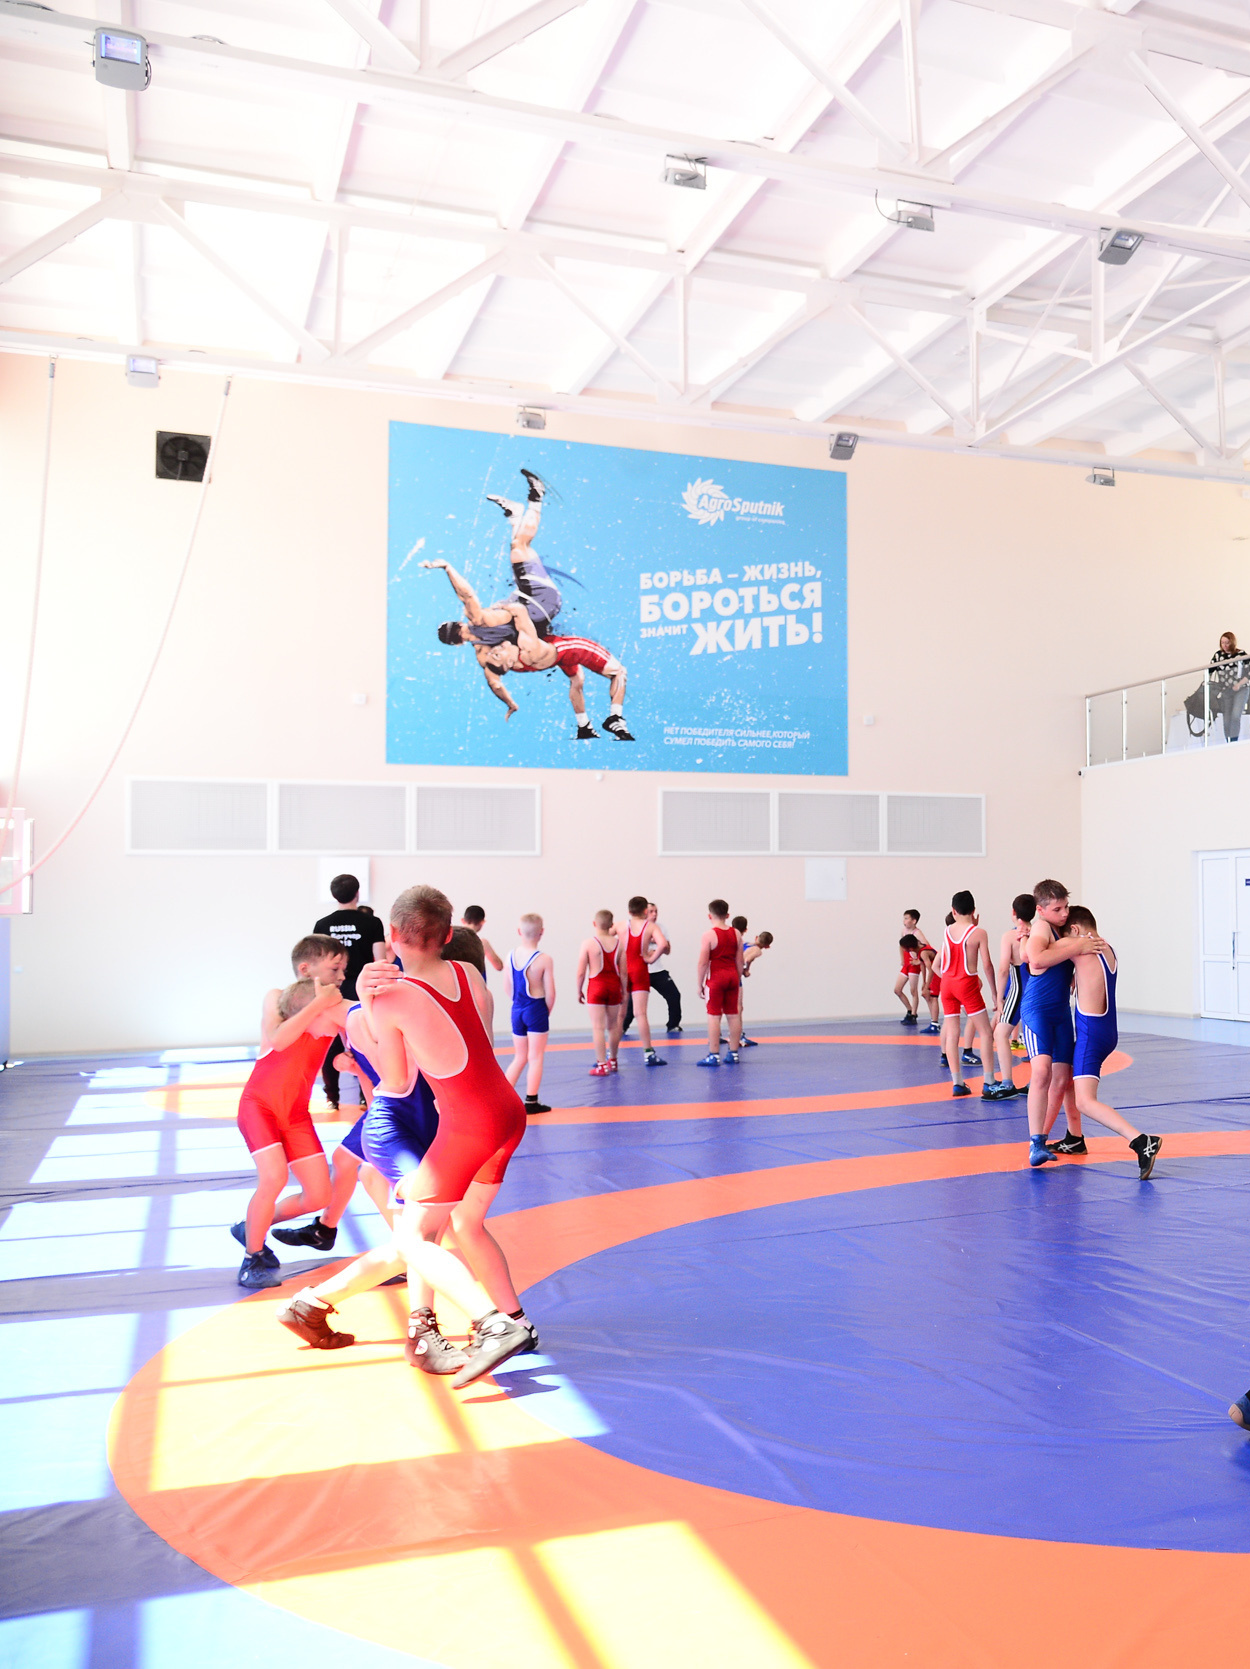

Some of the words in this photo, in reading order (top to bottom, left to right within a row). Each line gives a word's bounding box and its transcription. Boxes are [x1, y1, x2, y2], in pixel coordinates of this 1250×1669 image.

[699, 494, 785, 517] AgroSputnik
[639, 567, 723, 590] БОРЬБА
[742, 561, 822, 582] ЖИЗНЬ,
[639, 581, 822, 623] БОРОТЬСЯ
[639, 624, 689, 639] ЗНАЧИТ
[689, 612, 823, 656] ЖИТЬ!
[663, 726, 680, 735] НЕТ
[680, 727, 734, 737] ПОБЕДИТЕЛЯ
[663, 737, 693, 746] СУМЕЛ
[693, 738, 737, 747] ПОБЕДИТЬ
[737, 739, 772, 748] САМОГО
[772, 739, 796, 749] СЕБЯ!
